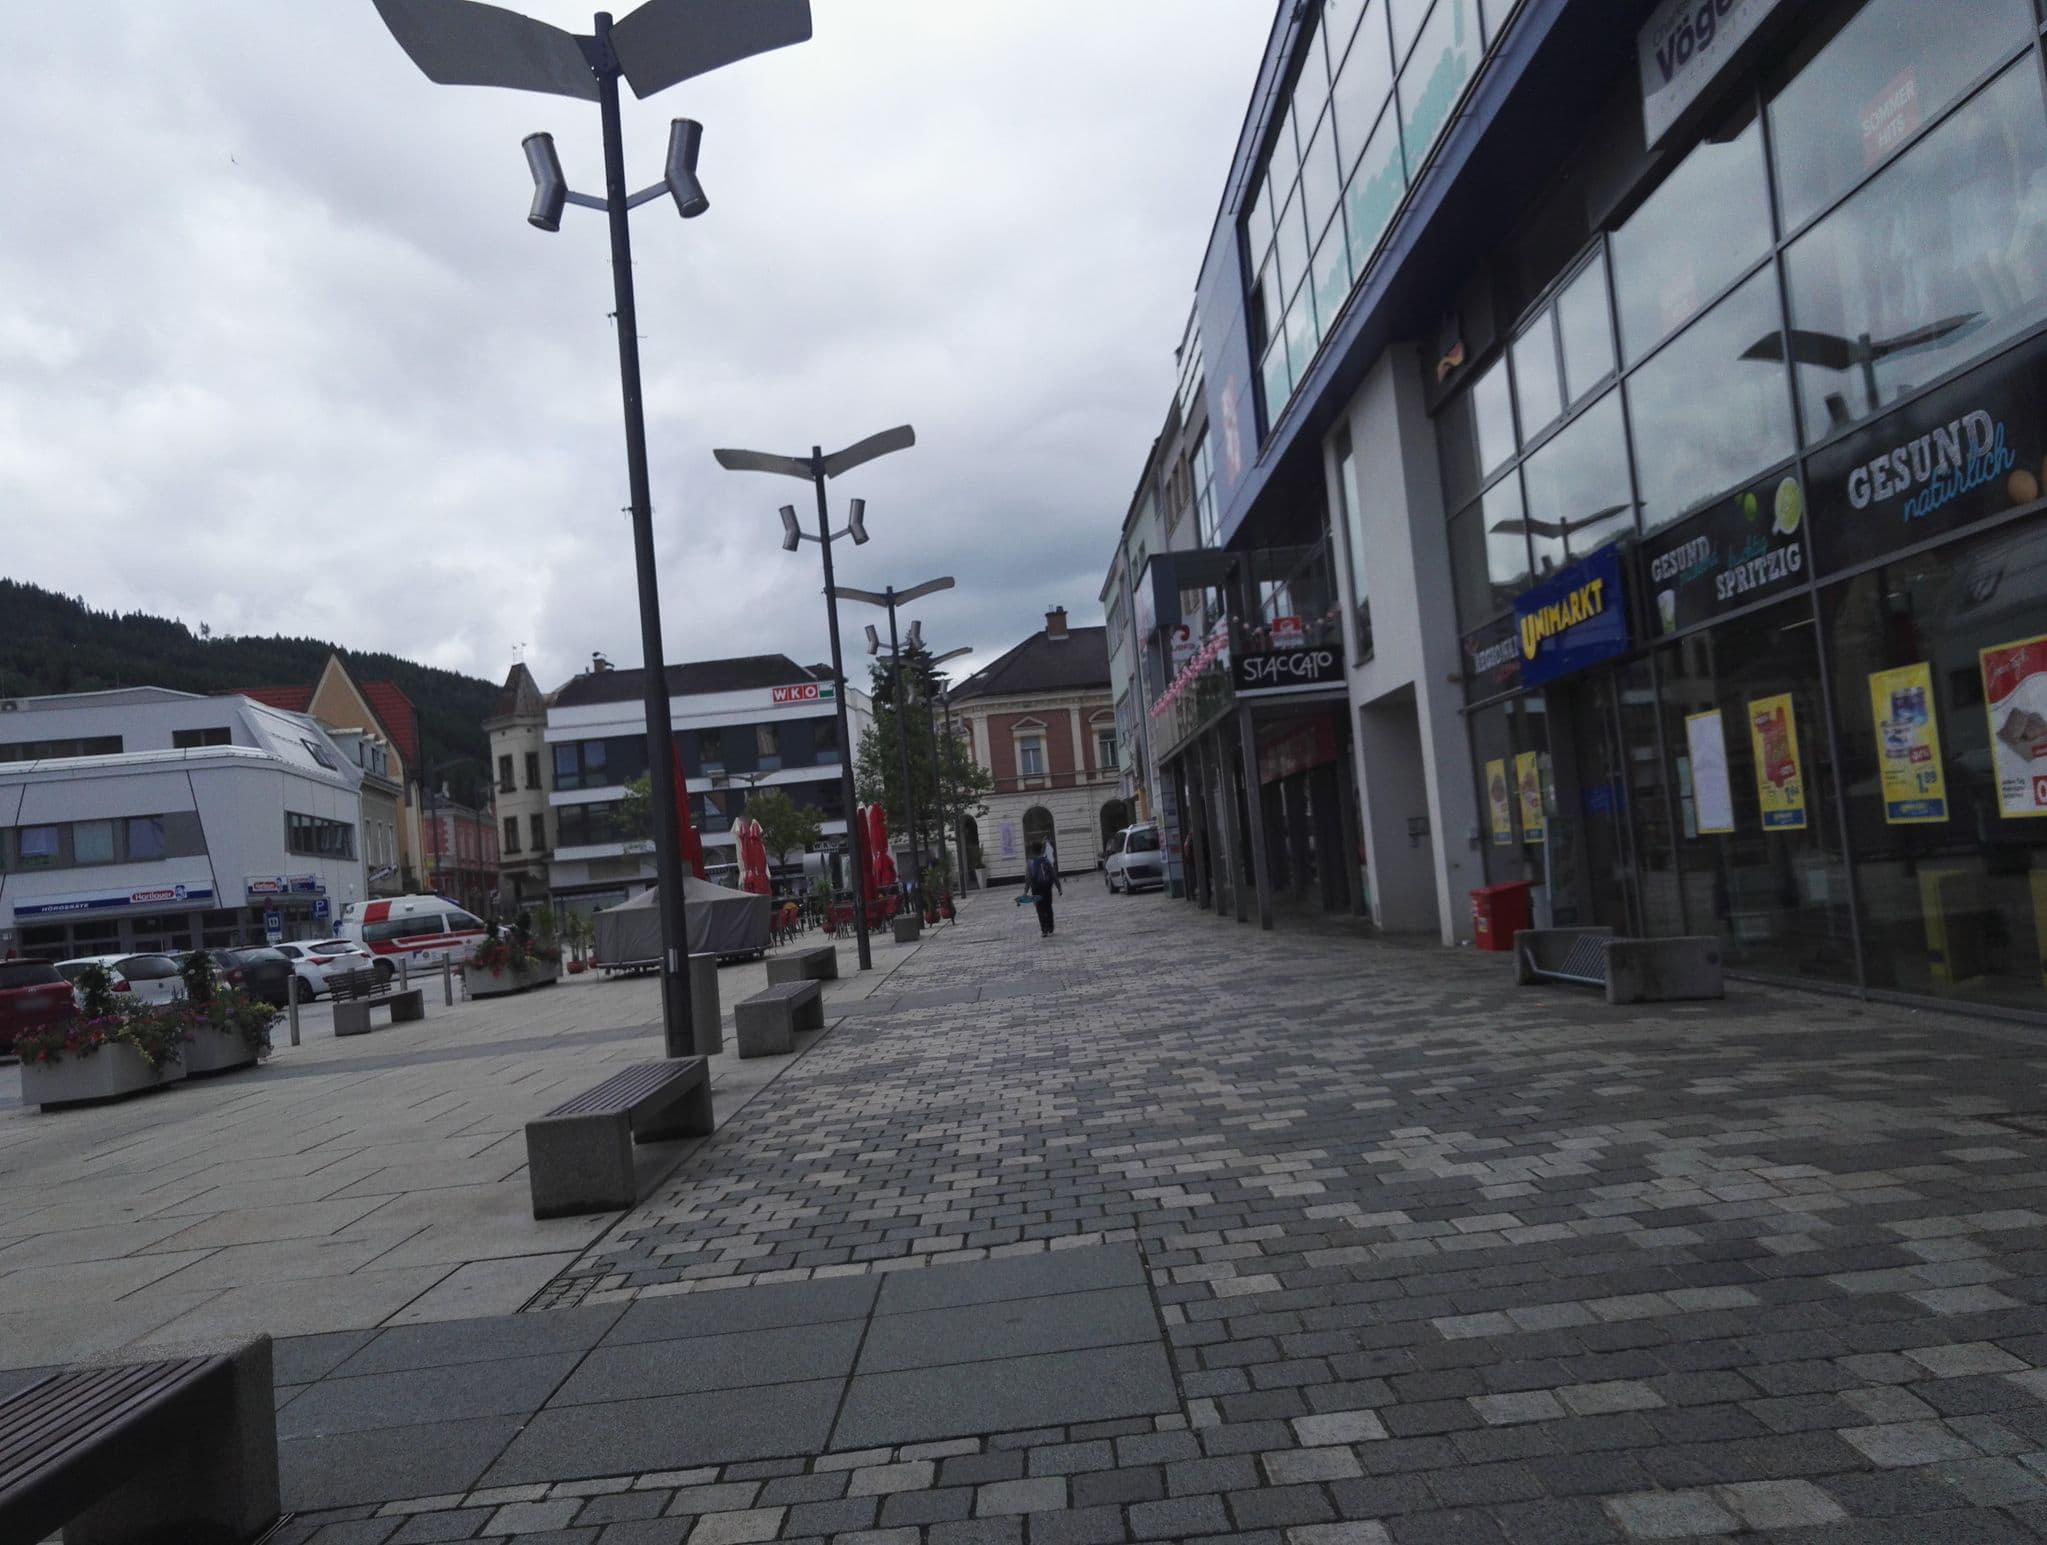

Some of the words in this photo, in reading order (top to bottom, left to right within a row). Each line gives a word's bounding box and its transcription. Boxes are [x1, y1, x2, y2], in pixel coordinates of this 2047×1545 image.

[1848, 409, 1994, 509] GESUND
[1651, 535, 1710, 582] GESUND
[1715, 542, 1801, 601] SPRITZIG
[1520, 577, 1603, 661] UNIMARKT
[773, 685, 817, 701] WKO
[1243, 651, 1333, 682] STACCATO
